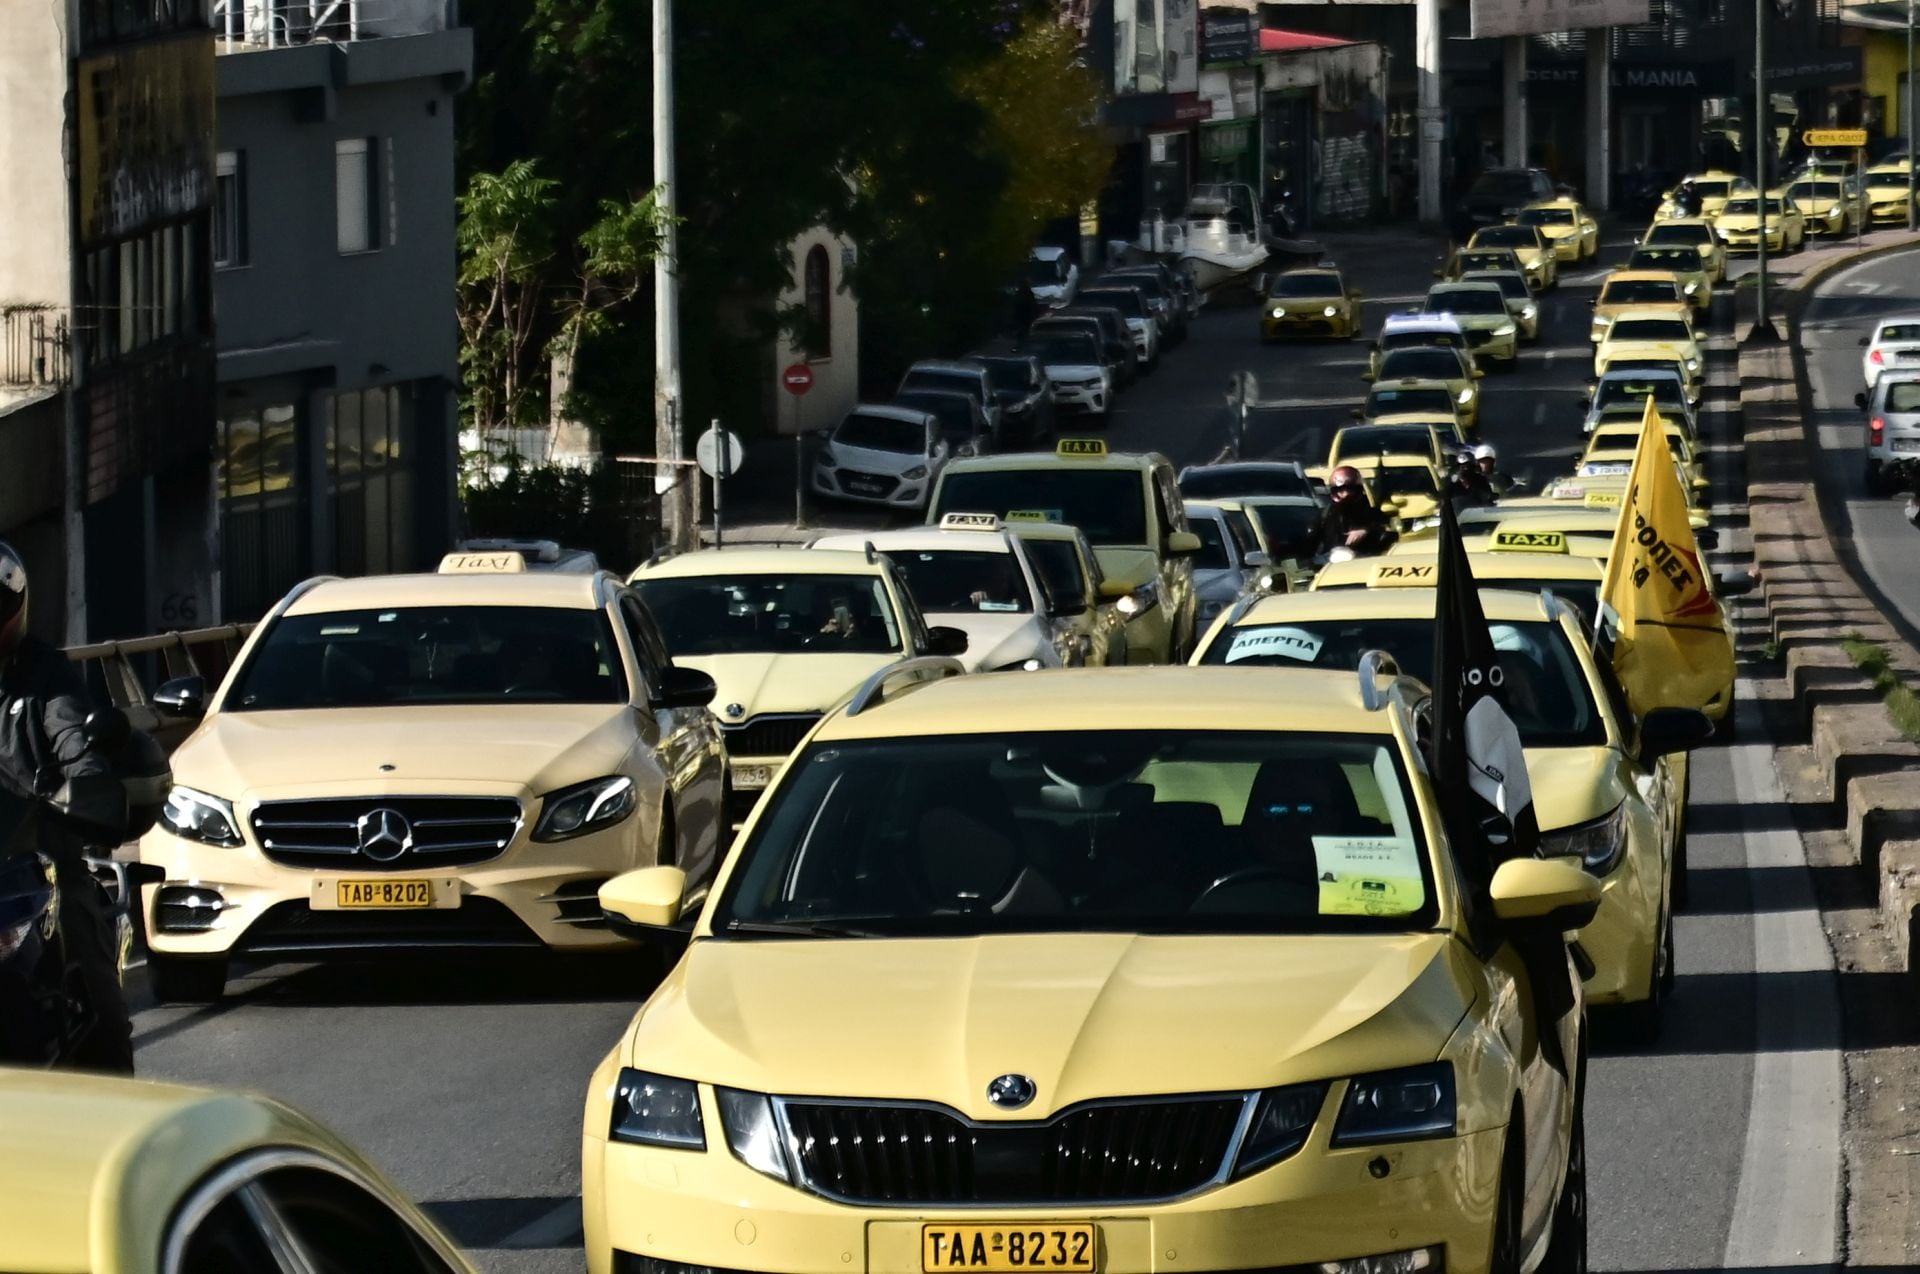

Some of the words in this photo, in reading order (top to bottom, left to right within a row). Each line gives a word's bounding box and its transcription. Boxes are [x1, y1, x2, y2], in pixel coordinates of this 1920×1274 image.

[1627, 70, 1697, 87] MANIA
[1065, 441, 1099, 452] TAXI
[1590, 495, 1617, 503] TAXI
[1501, 533, 1557, 546] TAXI
[1377, 565, 1433, 578] TAXI
[1234, 636, 1316, 651] ΑΠΕΡΓΙΑ
